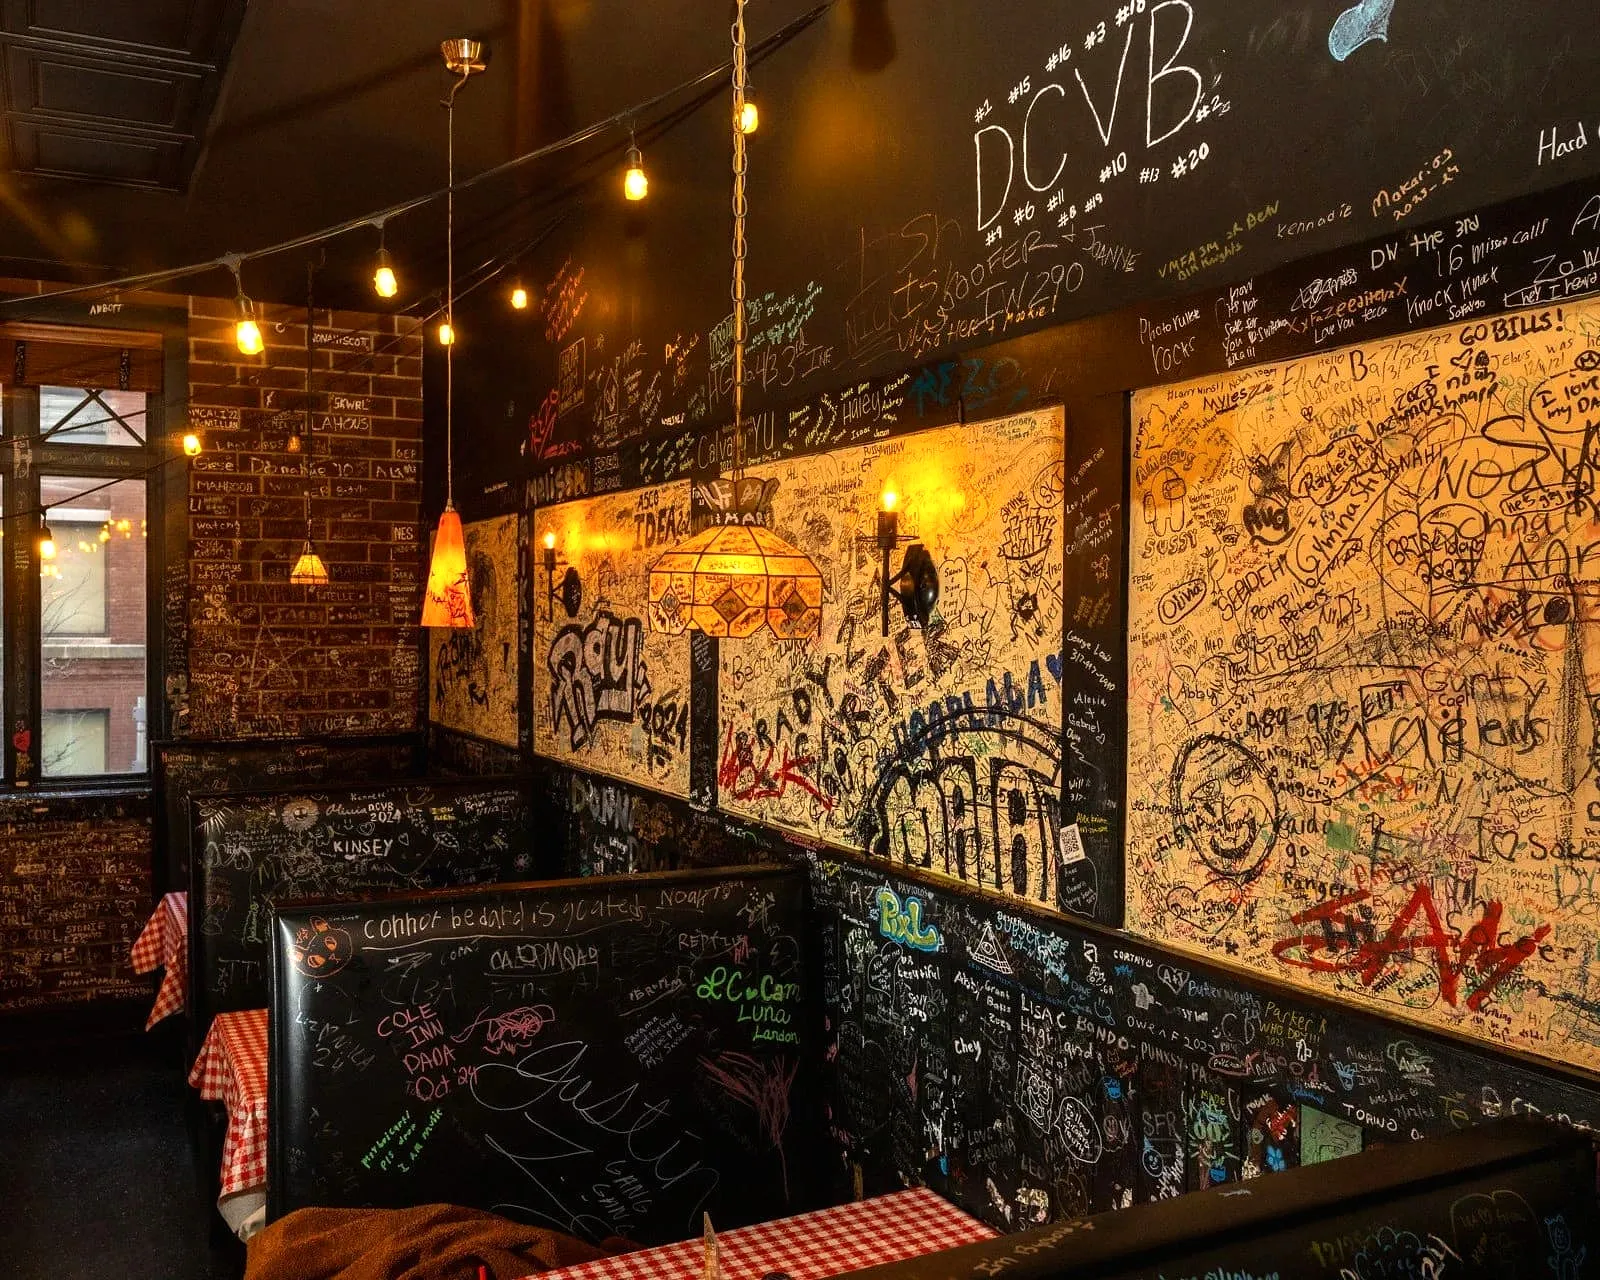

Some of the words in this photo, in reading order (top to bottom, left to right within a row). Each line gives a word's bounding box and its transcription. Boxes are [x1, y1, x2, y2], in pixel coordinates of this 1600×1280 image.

[1008, 75, 1031, 104] #15
[1045, 44, 1072, 72] #16
[1084, 21, 1106, 50] #3
[974, 0, 1201, 231] DCVB
[1537, 121, 1588, 166] Hard
[1013, 201, 1035, 226] #6
[1047, 189, 1065, 212] #11
[1084, 193, 1104, 213] #19
[1099, 152, 1126, 183] #10
[1139, 168, 1160, 183] #13
[1171, 142, 1209, 179] #20
[1410, 230, 1445, 257] the
[1455, 215, 1480, 238] 3rd
[1512, 218, 1549, 245] calls
[1140, 318, 1171, 345] Photo
[1460, 323, 1488, 346] GO
[1491, 308, 1564, 342] BILLS!
[843, 390, 880, 425] Haley
[333, 838, 394, 857] KINSEY
[760, 974, 800, 1002] Cam
[377, 1003, 437, 1038] COLE
[1264, 1000, 1315, 1032] Parker
[405, 1020, 444, 1049] INN
[753, 1026, 800, 1045] Landon
[416, 1075, 450, 1101] Oct
